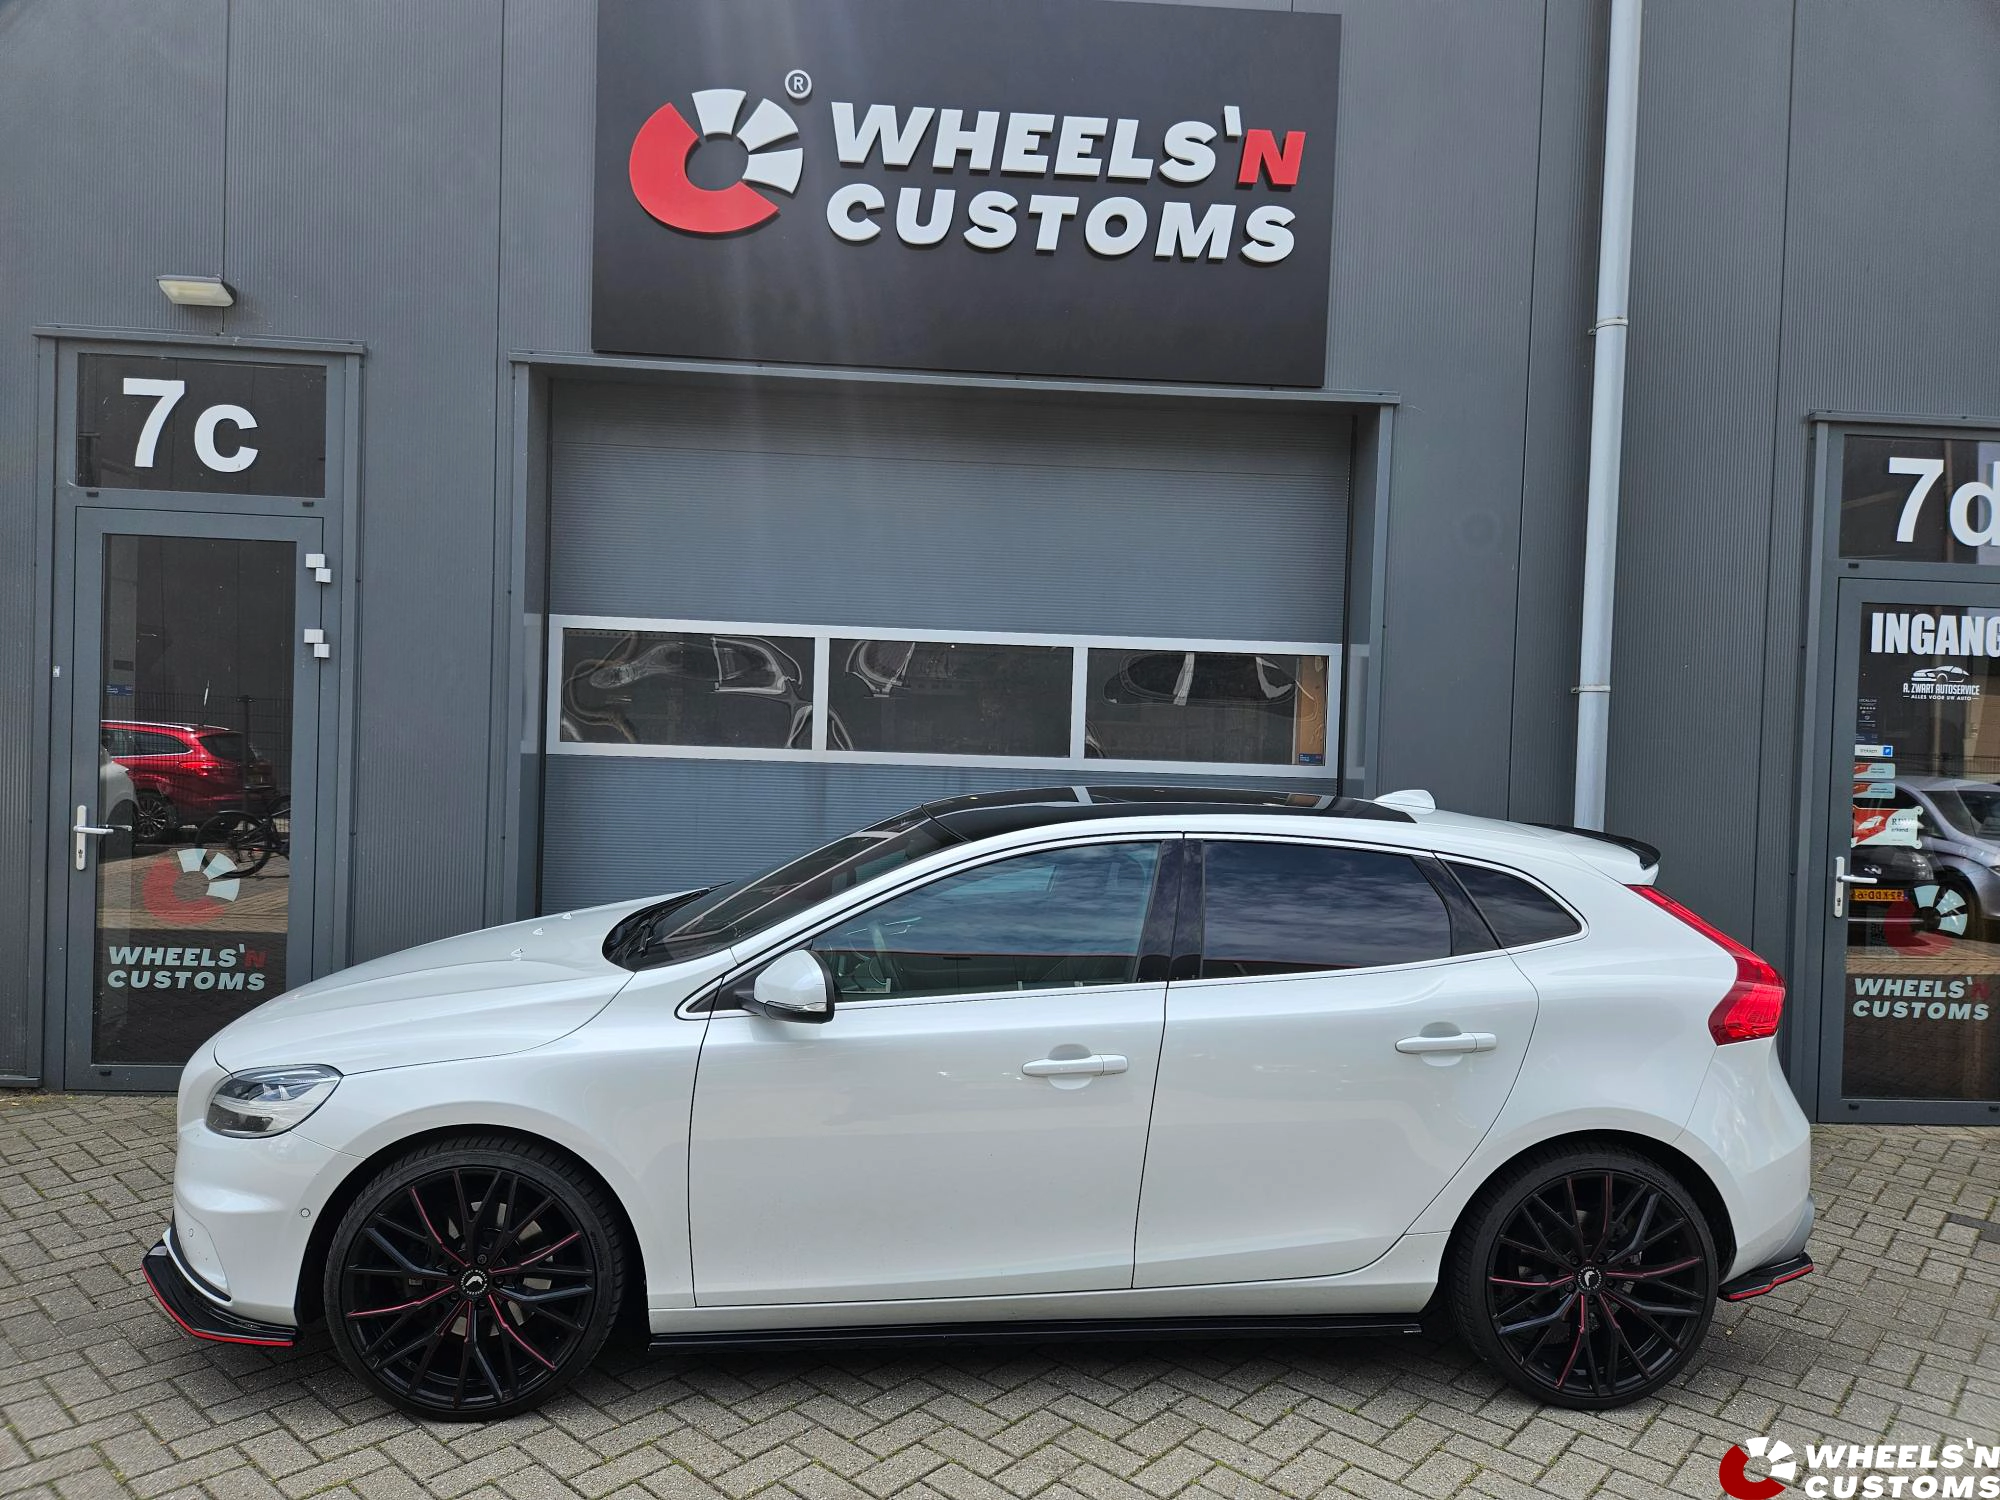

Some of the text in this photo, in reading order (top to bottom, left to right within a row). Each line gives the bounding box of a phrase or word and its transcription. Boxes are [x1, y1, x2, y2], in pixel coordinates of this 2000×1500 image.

[830, 101, 1306, 186] WHEELS'N
[826, 183, 1296, 263] CUSTOMS
[1911, 683, 1935, 694] ZWART
[1935, 684, 1981, 696] AUTOSERVICE
[107, 969, 266, 991] CUSTOMS
[1852, 1000, 1990, 1021] CUSTOMS
